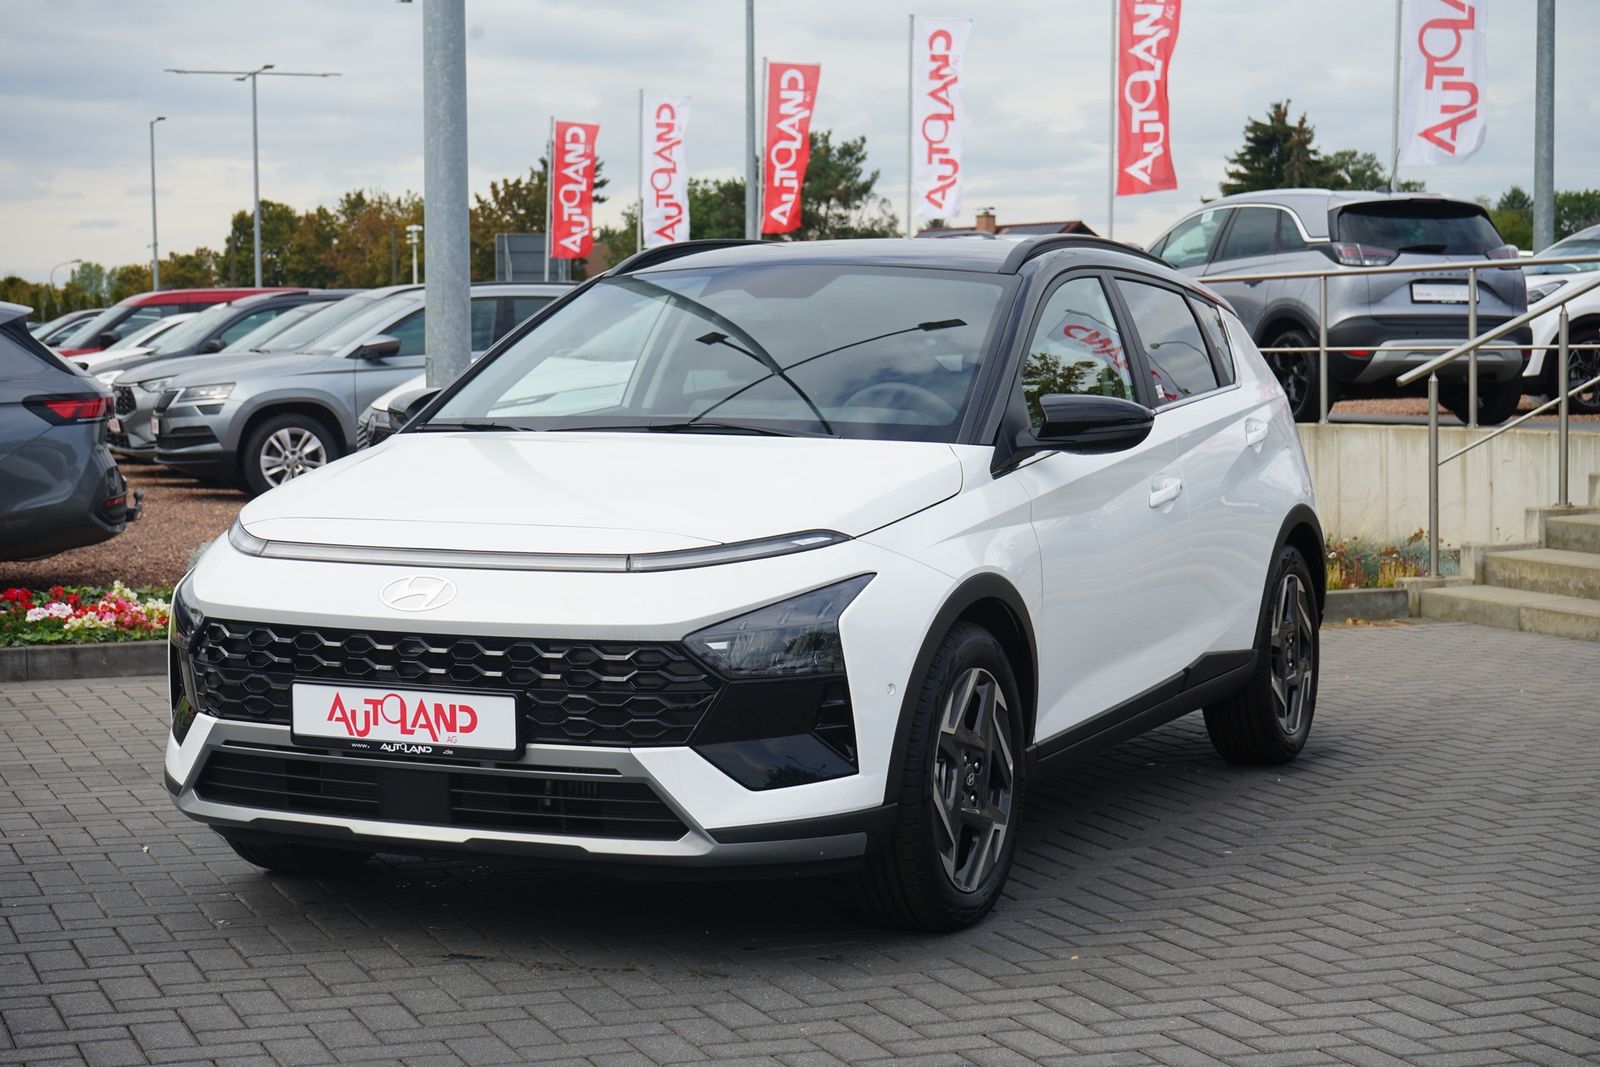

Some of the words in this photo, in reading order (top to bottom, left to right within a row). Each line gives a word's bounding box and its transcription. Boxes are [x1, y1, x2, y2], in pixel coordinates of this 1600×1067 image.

[770, 68, 811, 226] AUTOLAND
[922, 29, 959, 209] AUTOLAND
[1124, 0, 1170, 186] AUTOLAN
[559, 126, 592, 253] AUTOLAND
[650, 103, 683, 242] AUTOLAND
[327, 691, 478, 743] AUTOLAND
[380, 743, 433, 754] AUTOLAND
[446, 735, 458, 744] AG
